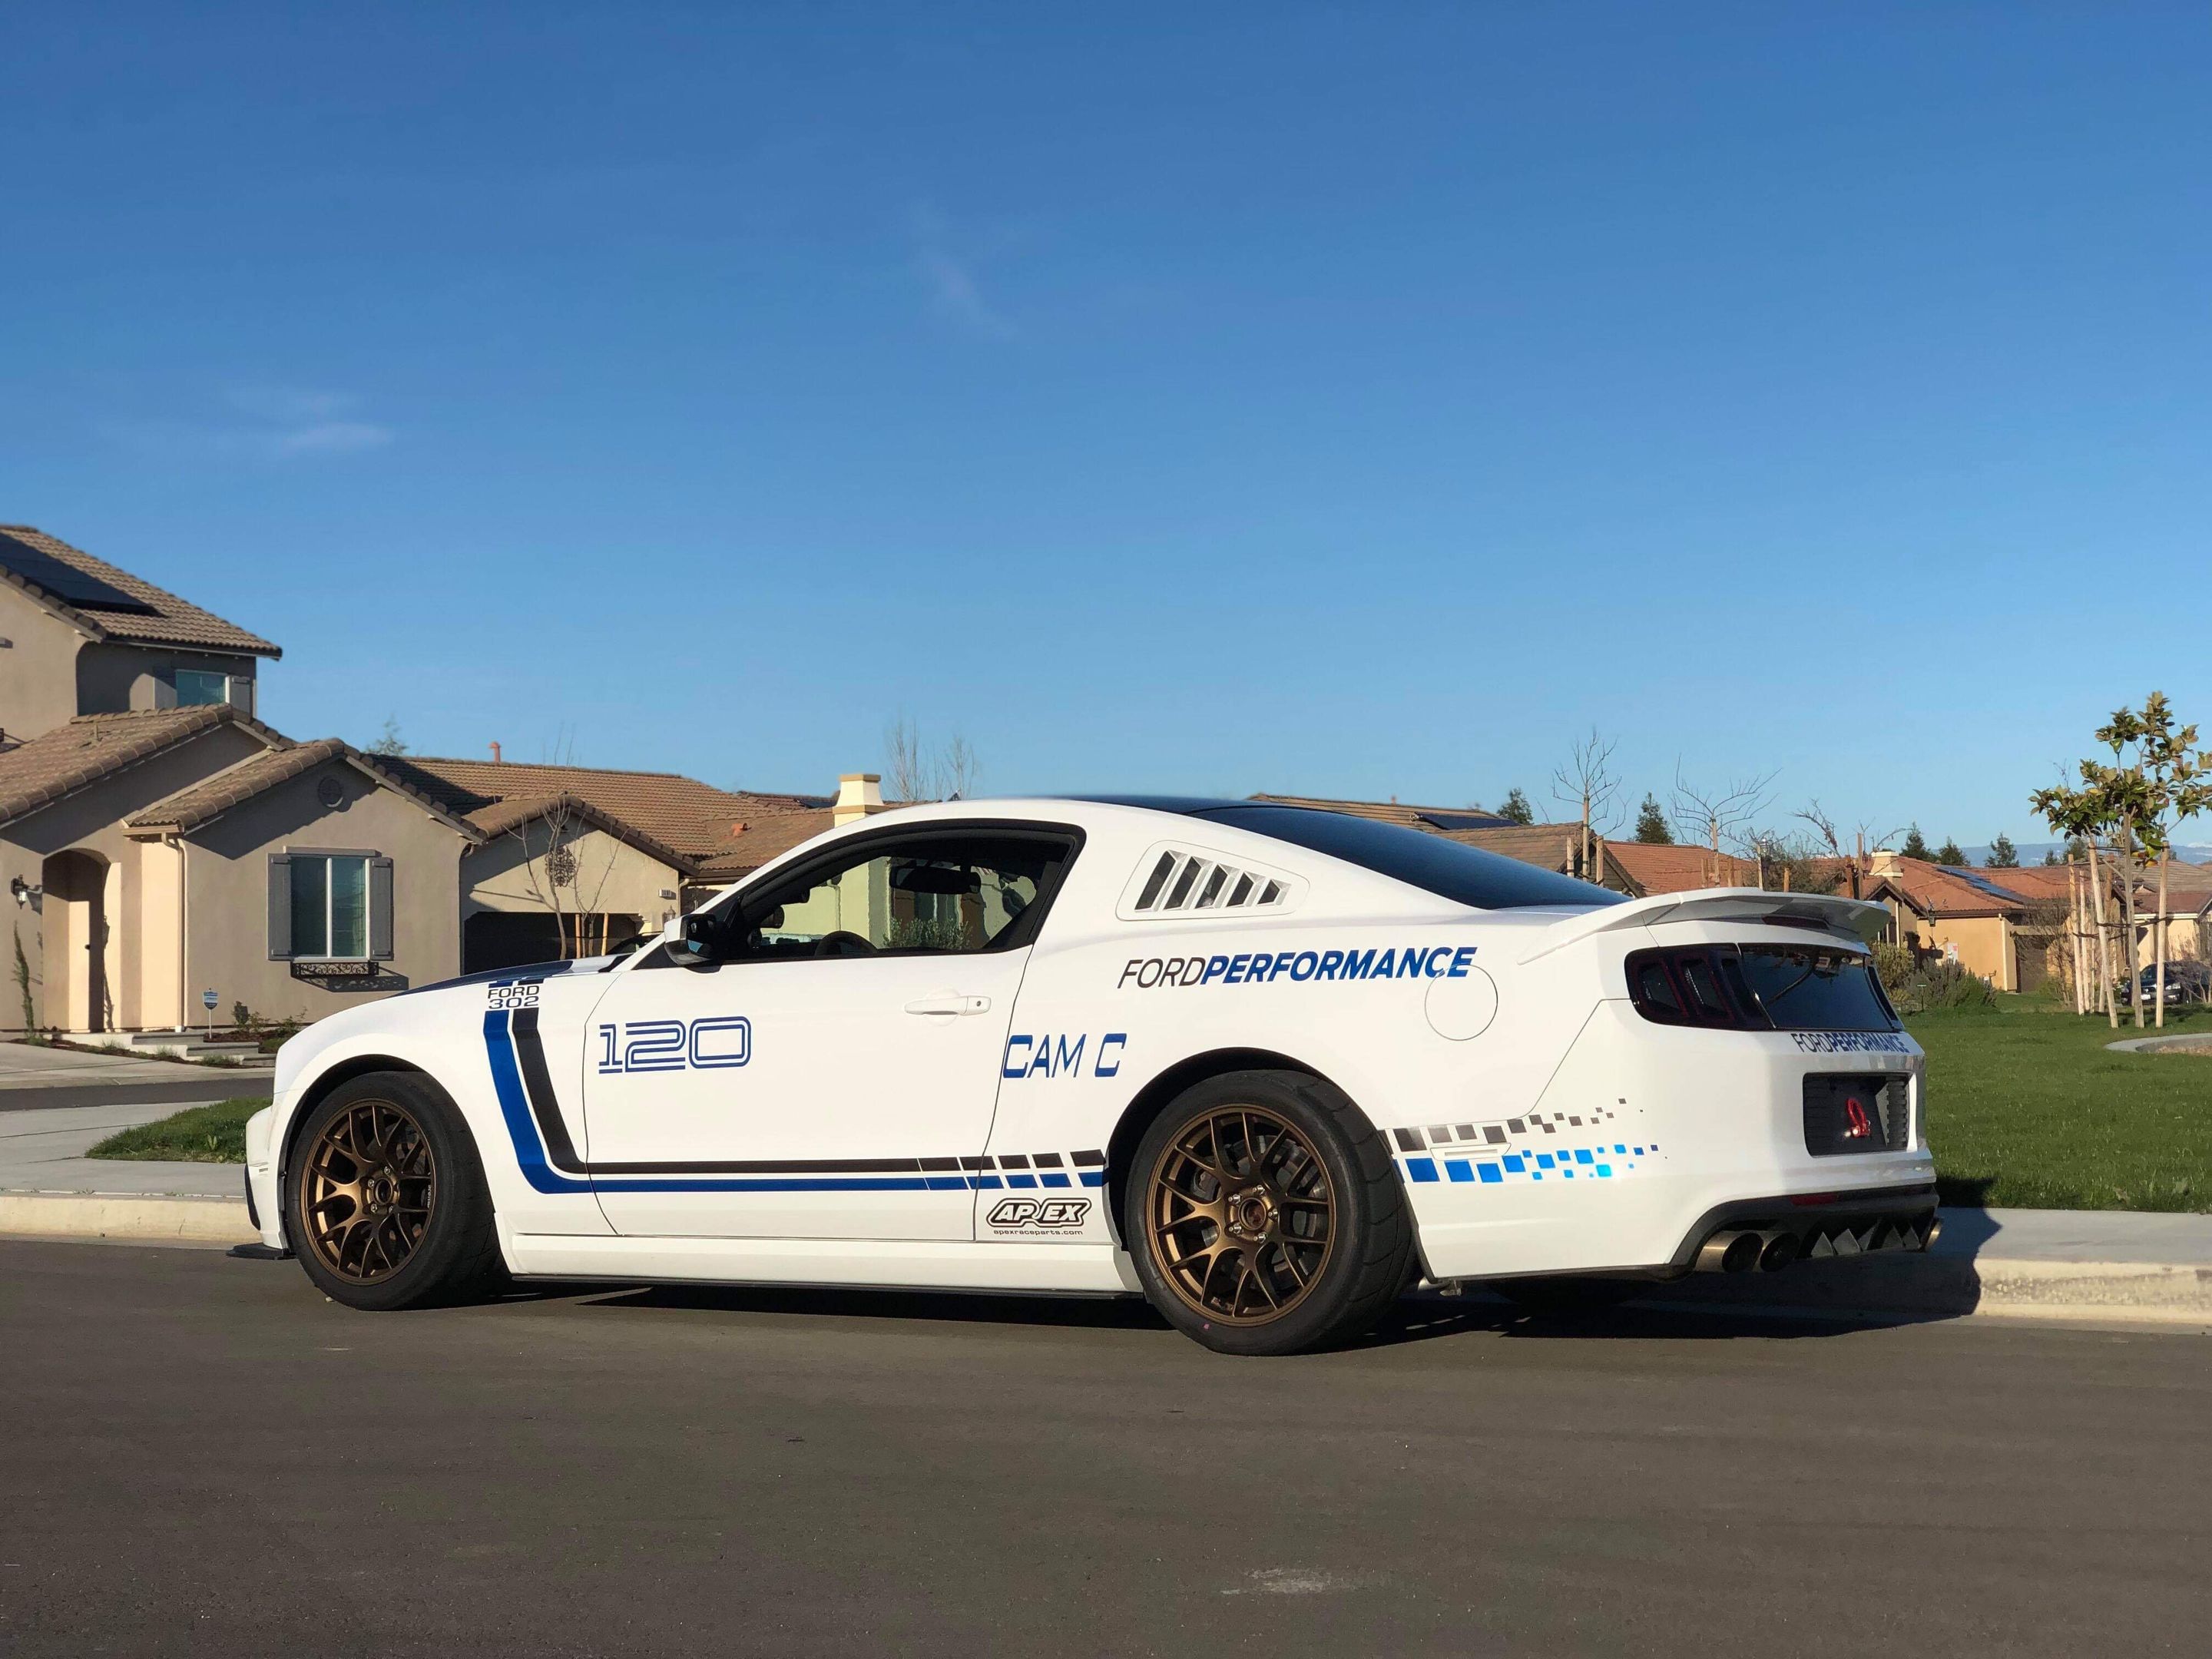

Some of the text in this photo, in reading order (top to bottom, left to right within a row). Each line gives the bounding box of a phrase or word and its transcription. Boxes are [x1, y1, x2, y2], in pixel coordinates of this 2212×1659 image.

[1118, 947, 1477, 988] FORDPERFORMANCE
[488, 985, 539, 998] FORD
[488, 996, 539, 1008] 302
[598, 1016, 751, 1074] 120
[1790, 1032, 1910, 1053] FORDPERFORMANCE
[1003, 1034, 1127, 1078] CAM C
[993, 1204, 1084, 1222] APEX
